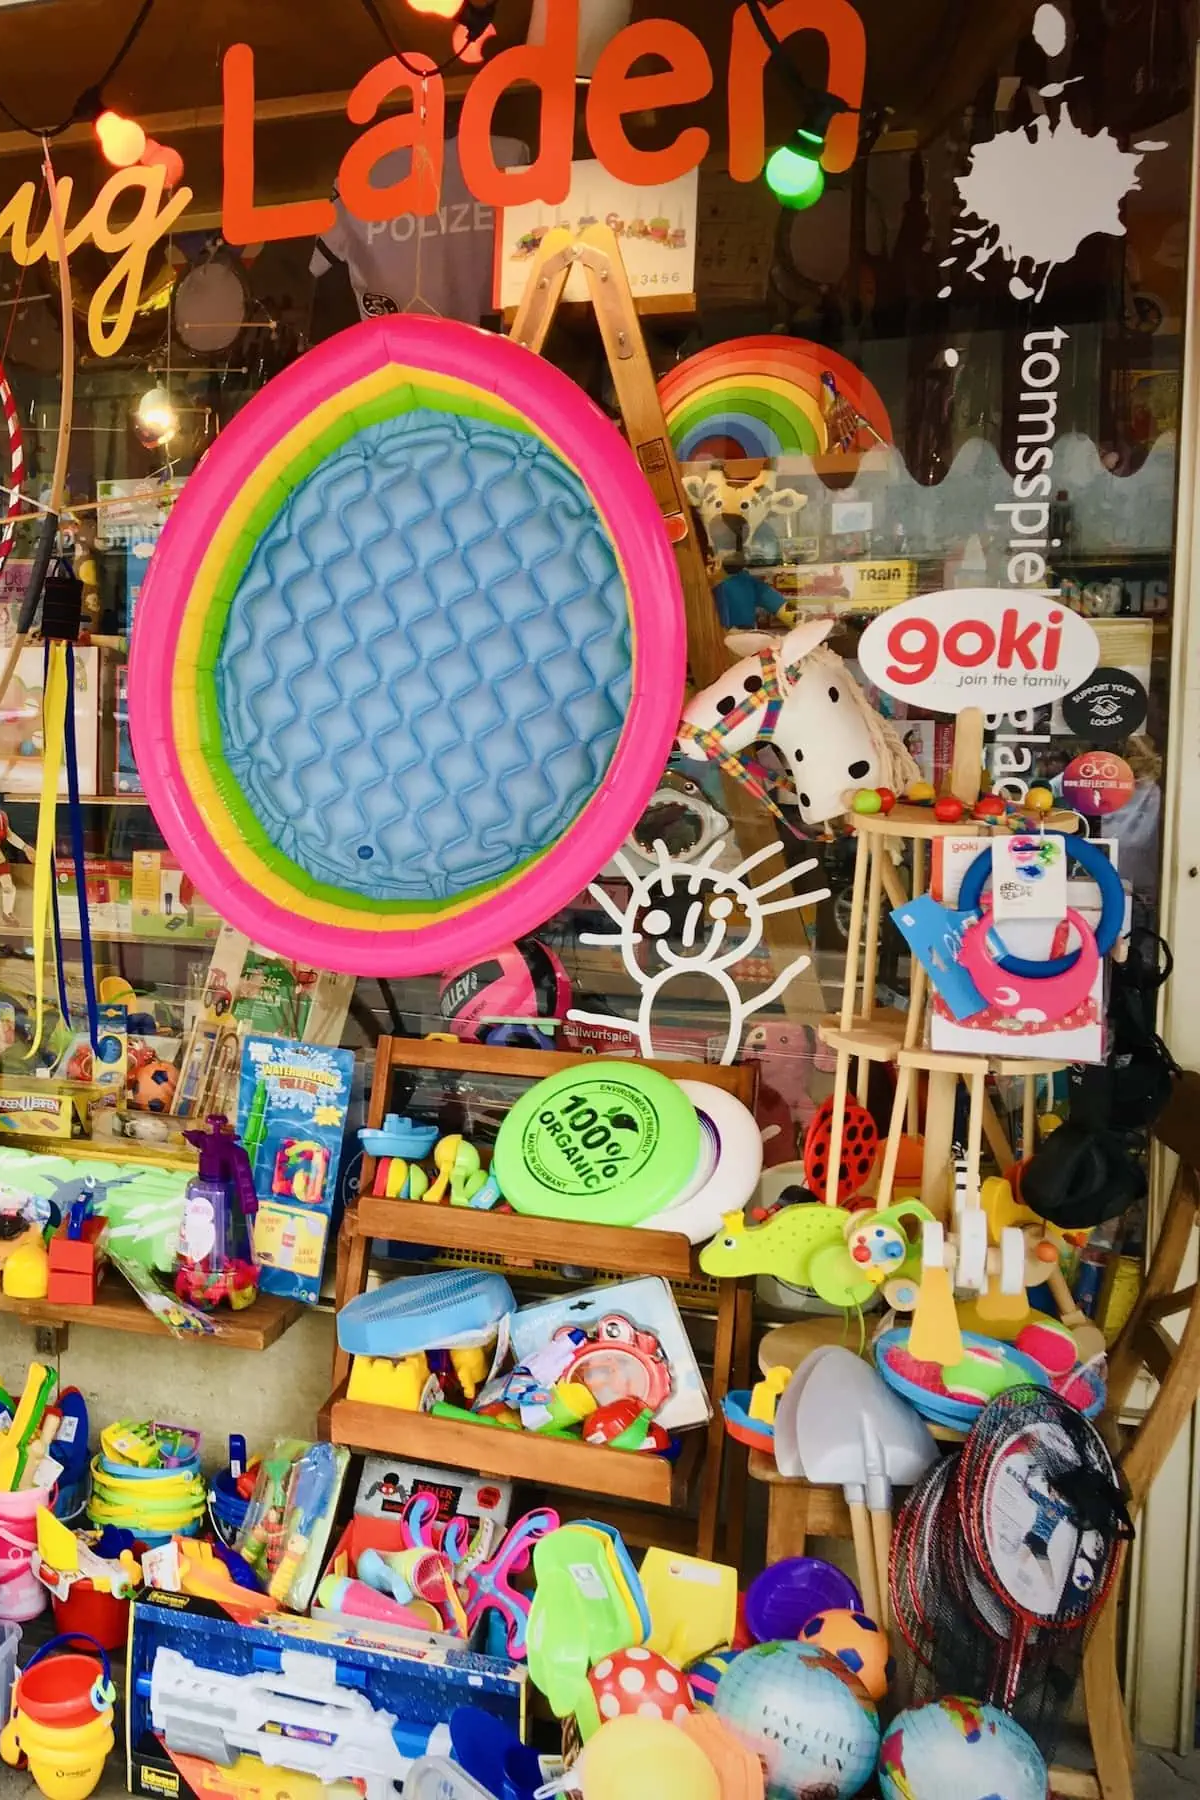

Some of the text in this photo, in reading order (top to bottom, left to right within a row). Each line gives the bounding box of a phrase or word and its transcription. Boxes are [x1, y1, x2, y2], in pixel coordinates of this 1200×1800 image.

[222, 0, 866, 245] Laden
[886, 609, 1064, 685] goki
[957, 672, 1071, 689] join the family
[1072, 683, 1137, 703] SUPPORT YOUR
[1090, 715, 1124, 727] LOCALS
[539, 1110, 601, 1189] ORGANIC
[560, 1094, 631, 1179] 100%
